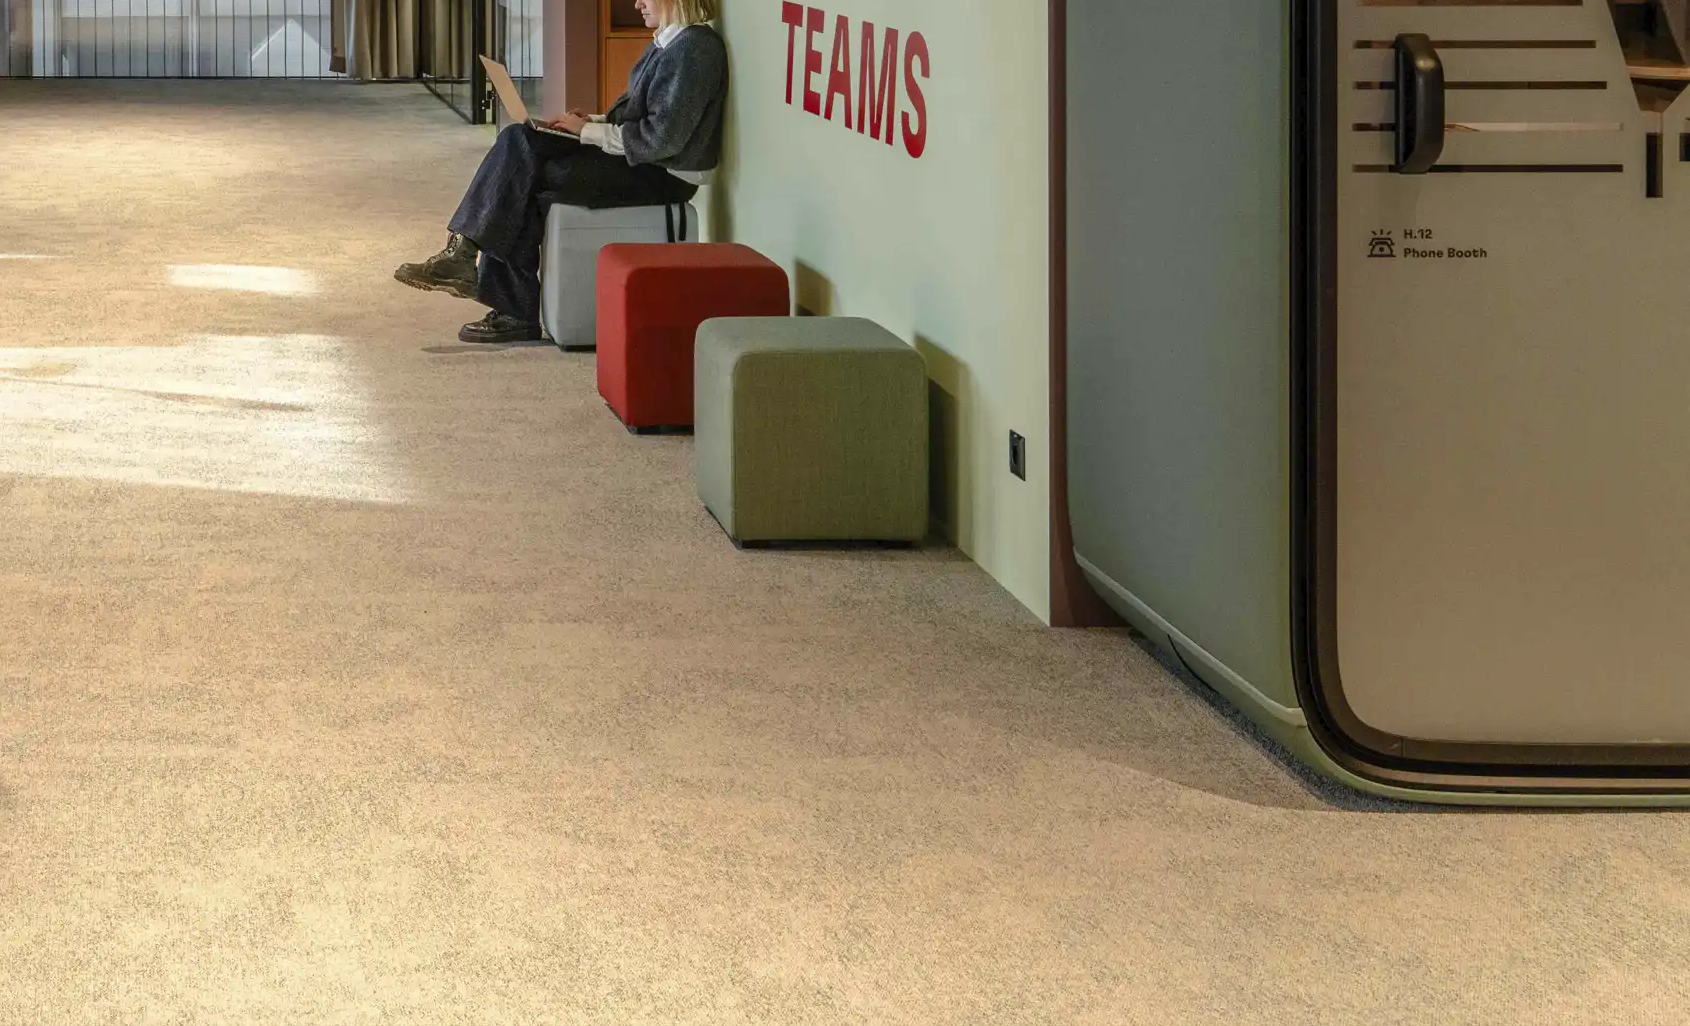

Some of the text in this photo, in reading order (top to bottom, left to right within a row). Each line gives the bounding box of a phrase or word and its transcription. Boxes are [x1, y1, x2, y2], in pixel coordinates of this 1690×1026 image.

[781, 0, 930, 159] TEAMS
[1403, 247, 1488, 258] Phone Booth
